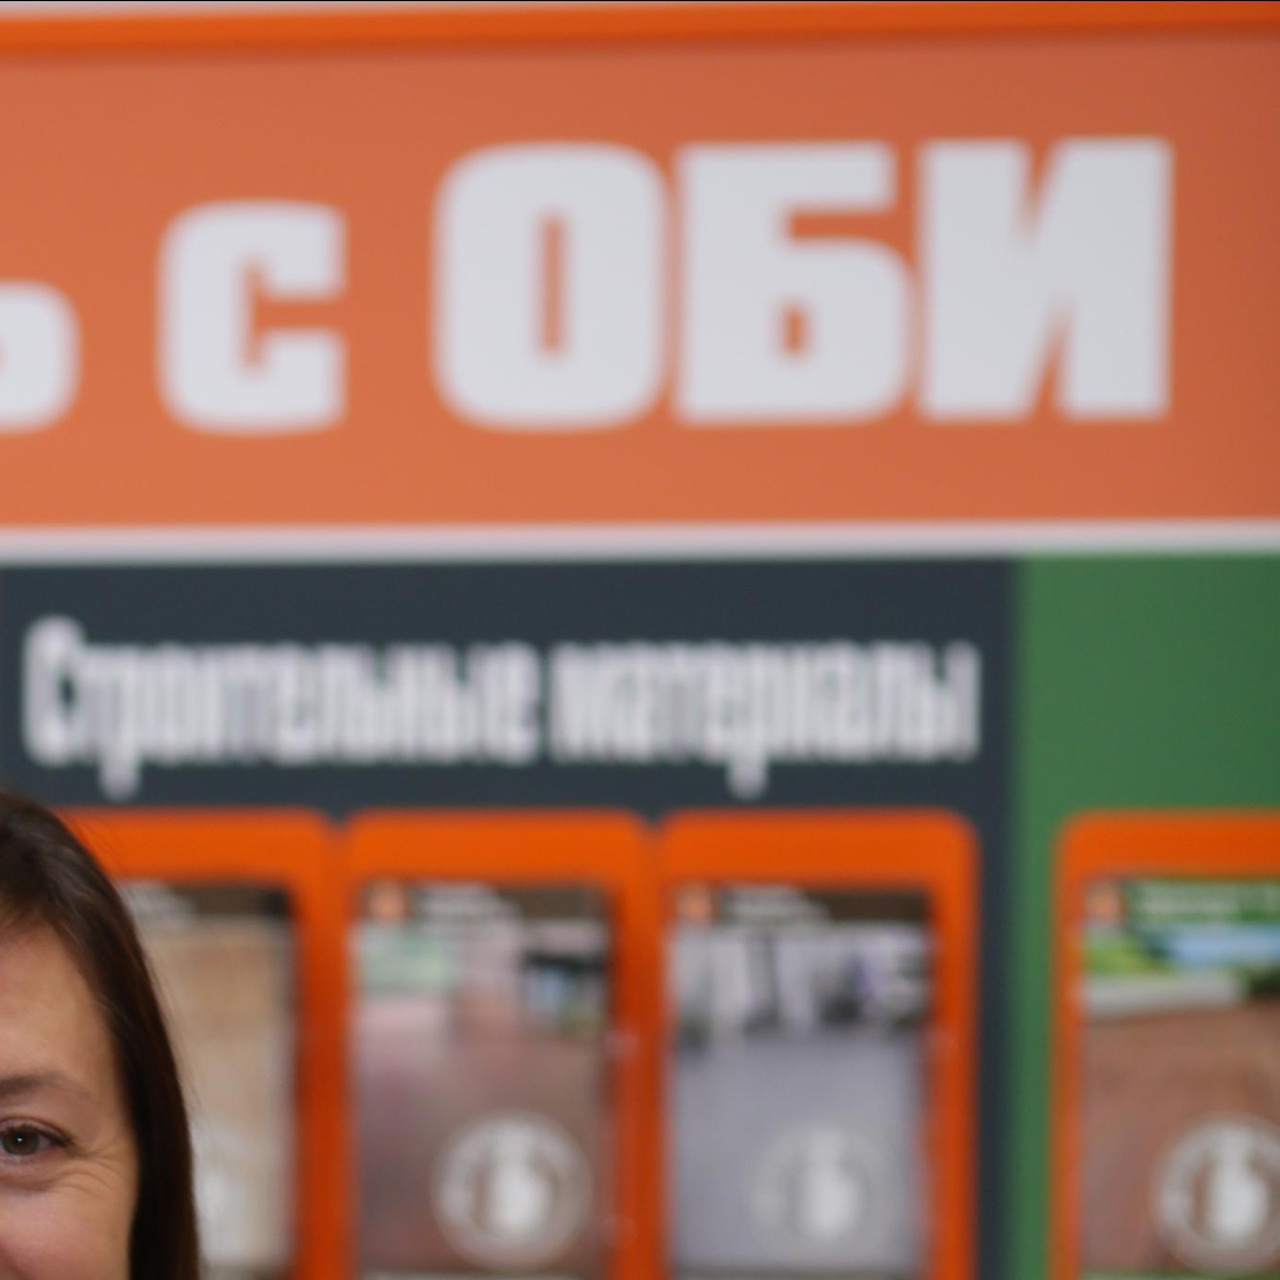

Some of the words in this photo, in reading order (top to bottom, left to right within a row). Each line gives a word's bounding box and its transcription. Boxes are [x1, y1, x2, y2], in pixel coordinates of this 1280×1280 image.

[157, 201, 345, 435] с
[432, 138, 1172, 431] ОБИ
[23, 617, 543, 794] Строительные
[547, 641, 980, 794] материалы
